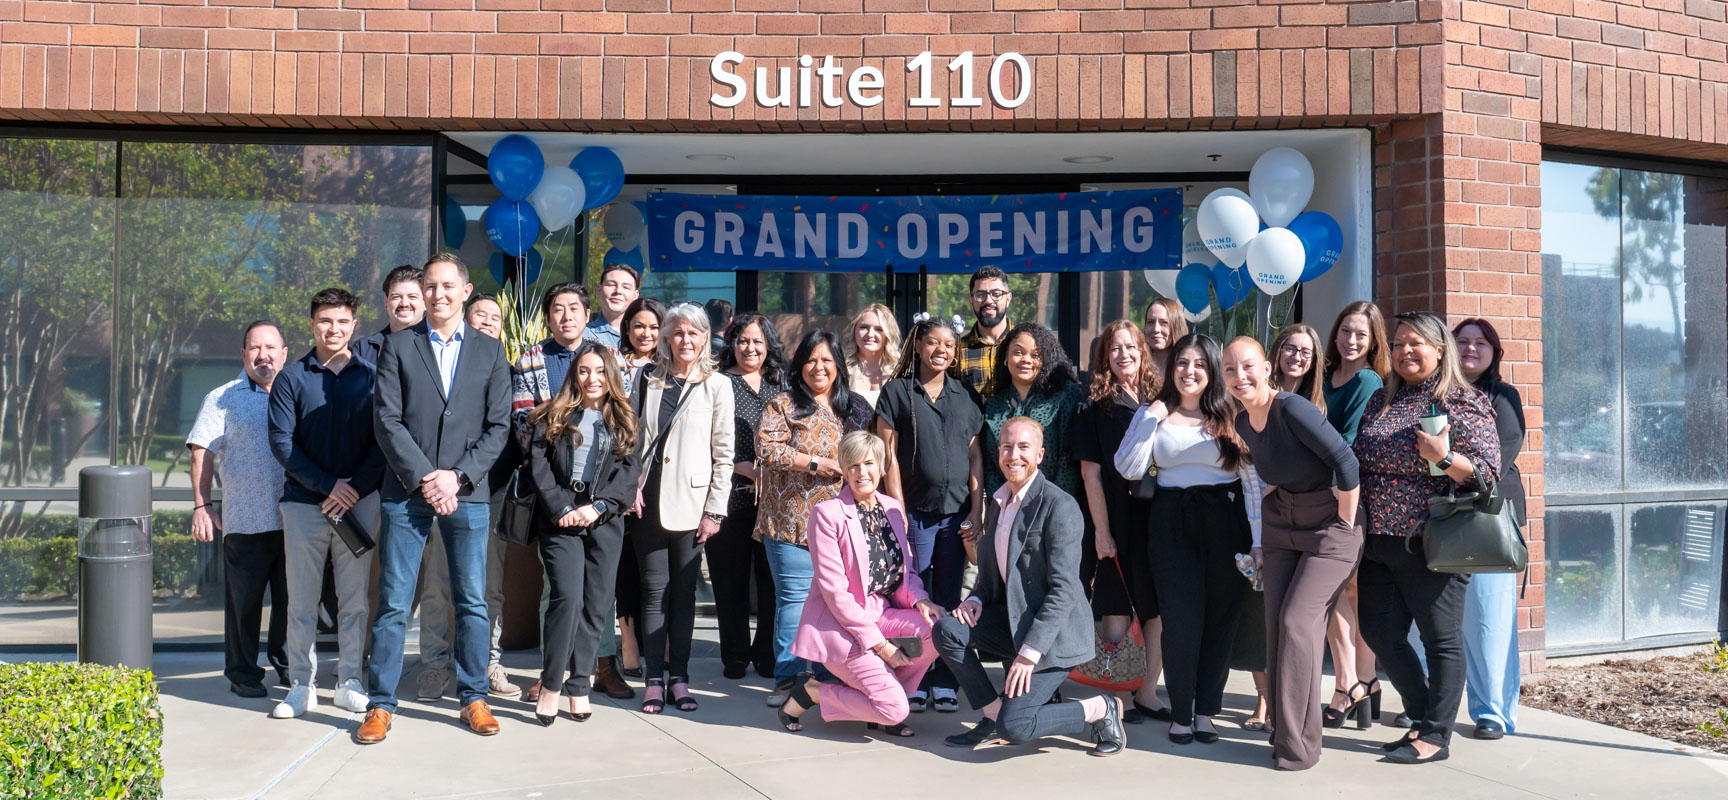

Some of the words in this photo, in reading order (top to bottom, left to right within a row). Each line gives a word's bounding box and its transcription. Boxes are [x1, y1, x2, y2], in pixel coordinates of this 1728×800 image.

[710, 50, 884, 108] Suite
[907, 50, 1032, 109] 110
[673, 209, 869, 259] GRAND
[897, 205, 1154, 259] OPENING
[1258, 272, 1285, 280] GRAND
